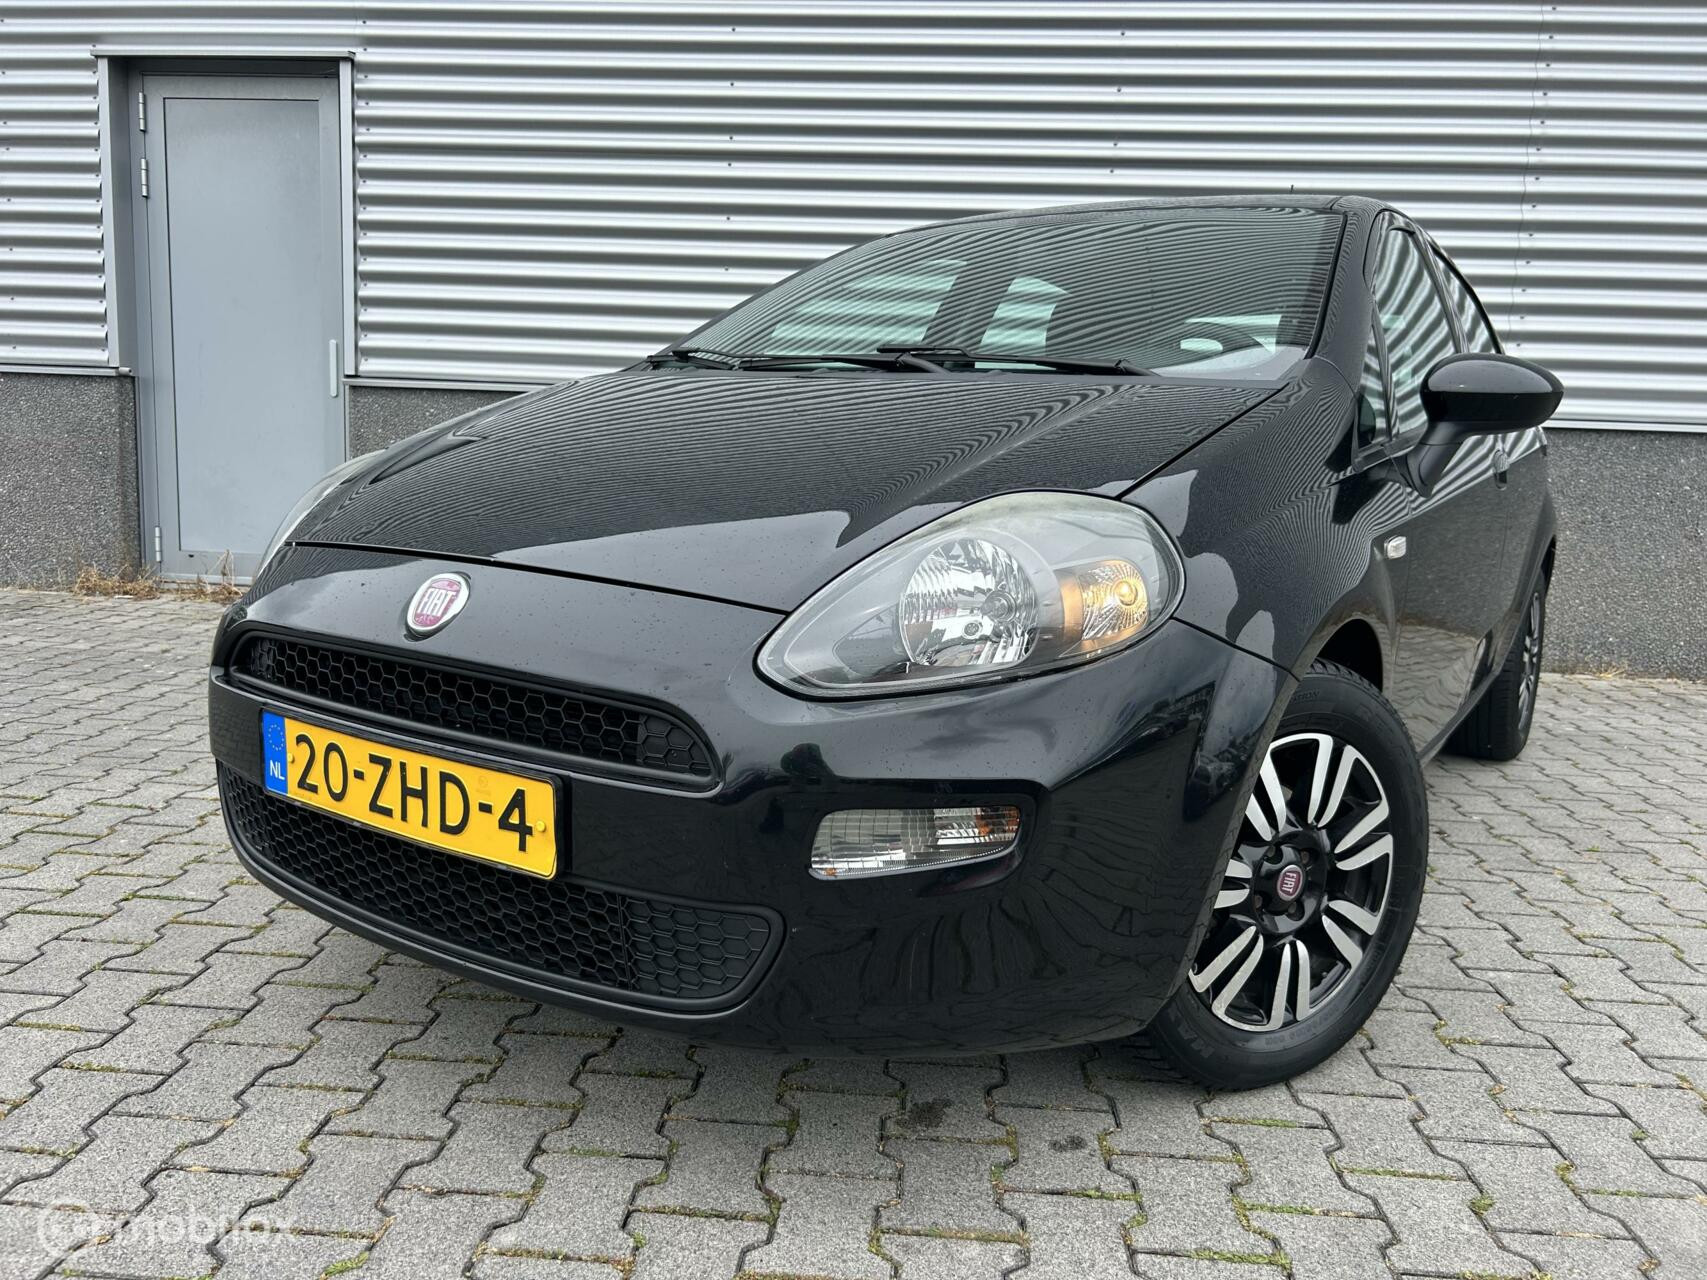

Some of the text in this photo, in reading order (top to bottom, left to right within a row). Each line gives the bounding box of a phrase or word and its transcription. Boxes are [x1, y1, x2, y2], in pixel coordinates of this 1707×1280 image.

[416, 588, 457, 617] FIAT
[269, 759, 286, 781] NL
[295, 733, 534, 852] 20-ZHD-4
[1281, 872, 1297, 894] FIAT
